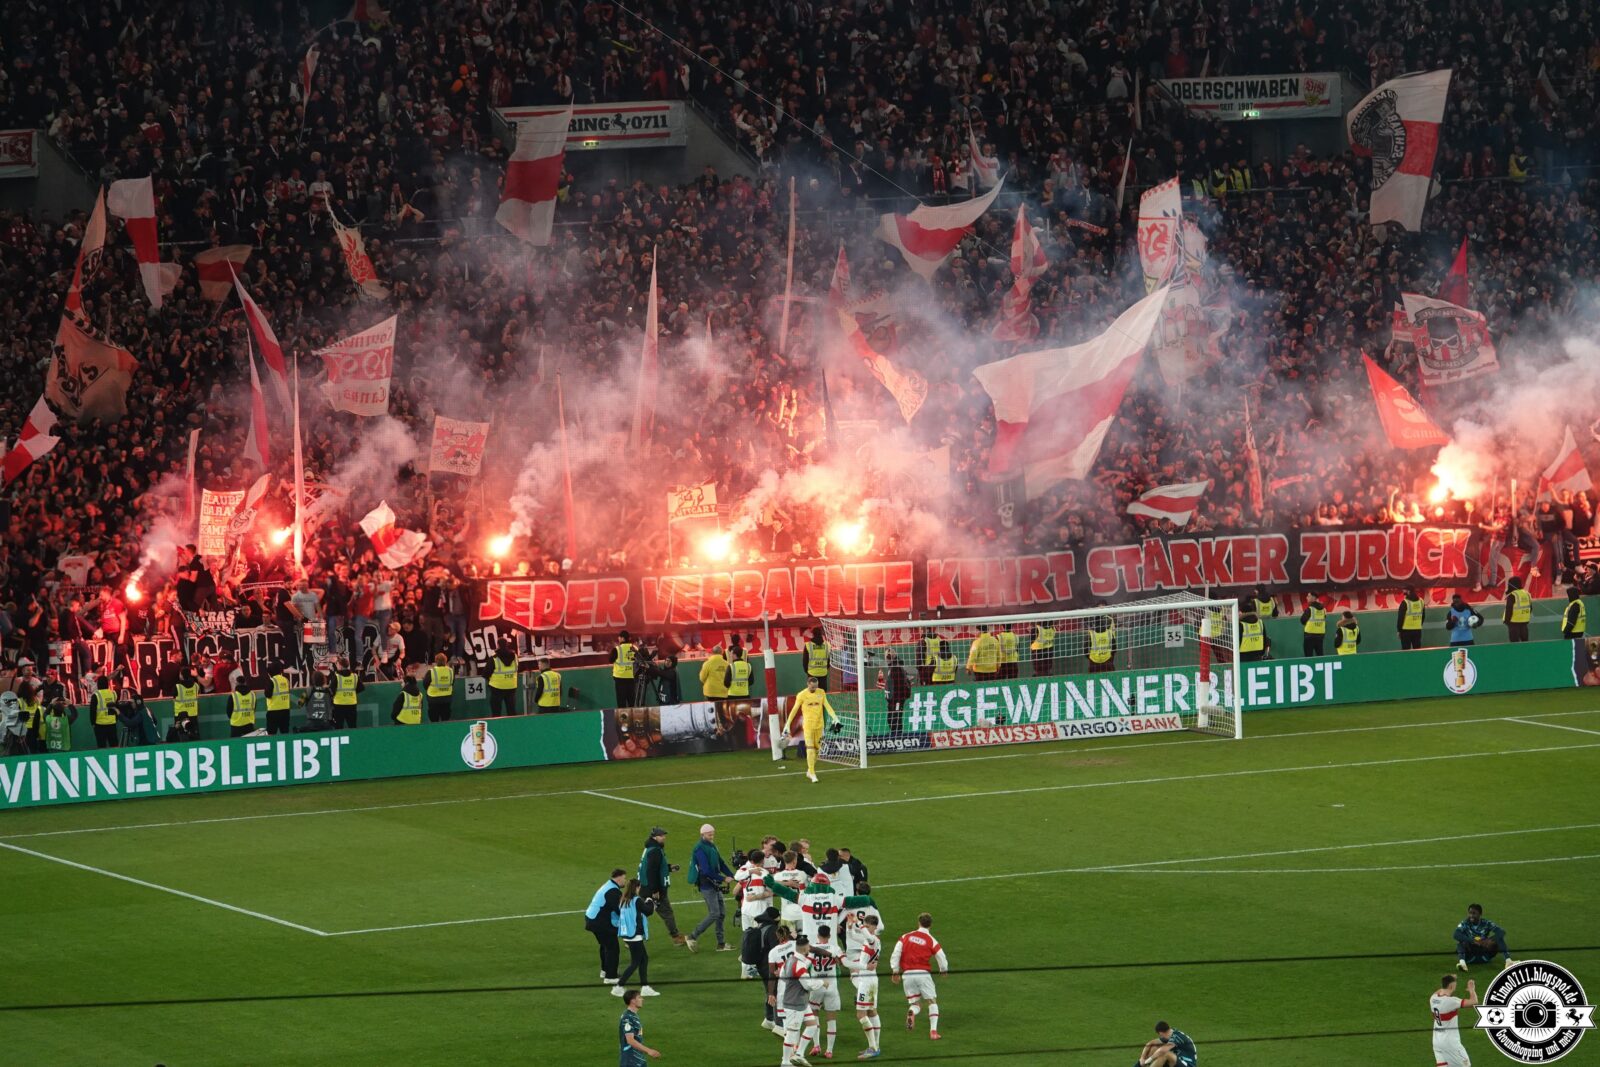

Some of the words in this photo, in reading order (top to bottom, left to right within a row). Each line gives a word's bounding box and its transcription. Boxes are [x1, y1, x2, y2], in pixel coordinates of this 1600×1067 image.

[1171, 77, 1299, 101] OBERSCHWABEN
[631, 114, 669, 130] 0711
[479, 576, 630, 631] JEDER
[641, 560, 914, 625] VERBANNTE
[926, 550, 1076, 610] KEHRT
[1087, 532, 1290, 598] STÄRKER
[1300, 523, 1472, 584] ZURÜCK
[1167, 631, 1182, 642] 35
[468, 683, 483, 694] 34
[834, 736, 921, 751] Volswagen
[950, 725, 1038, 748] STRAUSS
[812, 901, 832, 920] 92
[813, 953, 834, 972] 32
